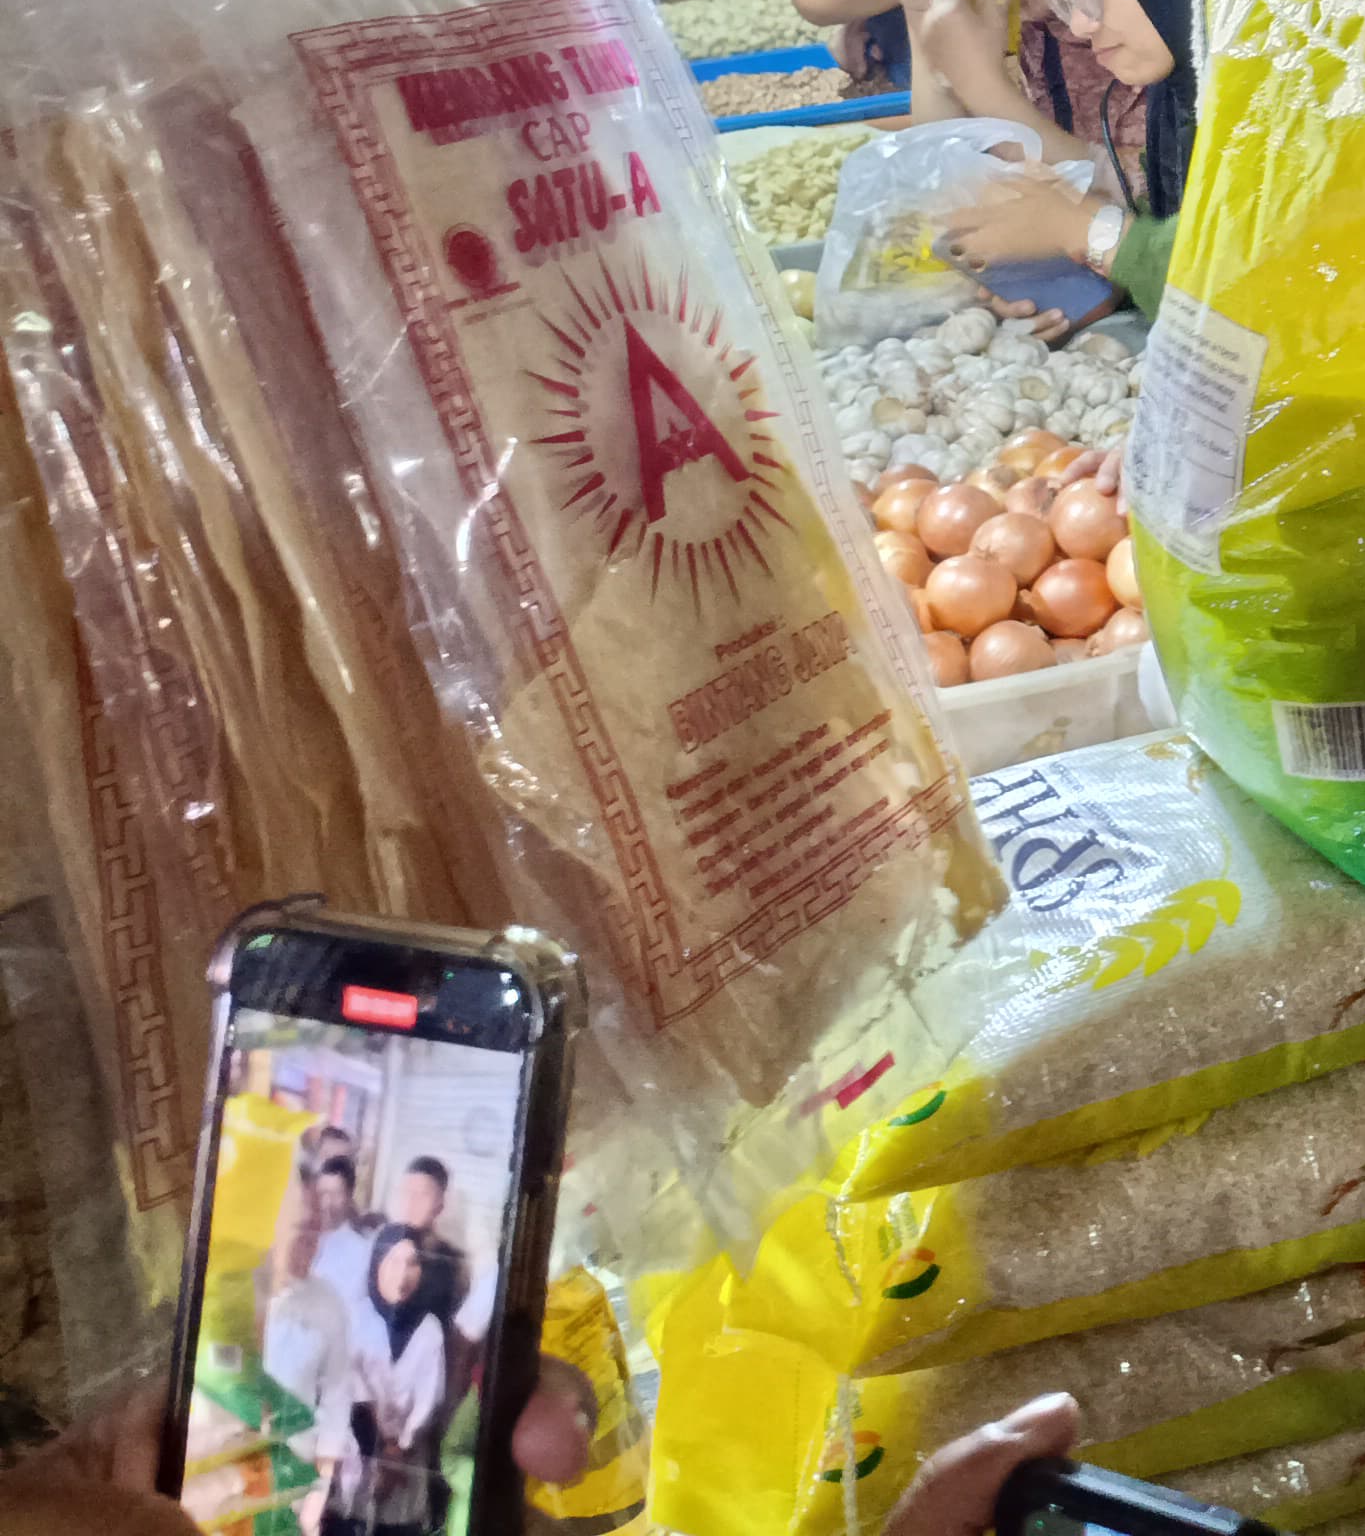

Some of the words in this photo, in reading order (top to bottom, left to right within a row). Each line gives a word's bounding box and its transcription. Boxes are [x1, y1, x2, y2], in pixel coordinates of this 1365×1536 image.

[521, 112, 591, 162] CAP
[506, 151, 662, 254] SATU-A
[625, 322, 752, 526] A
